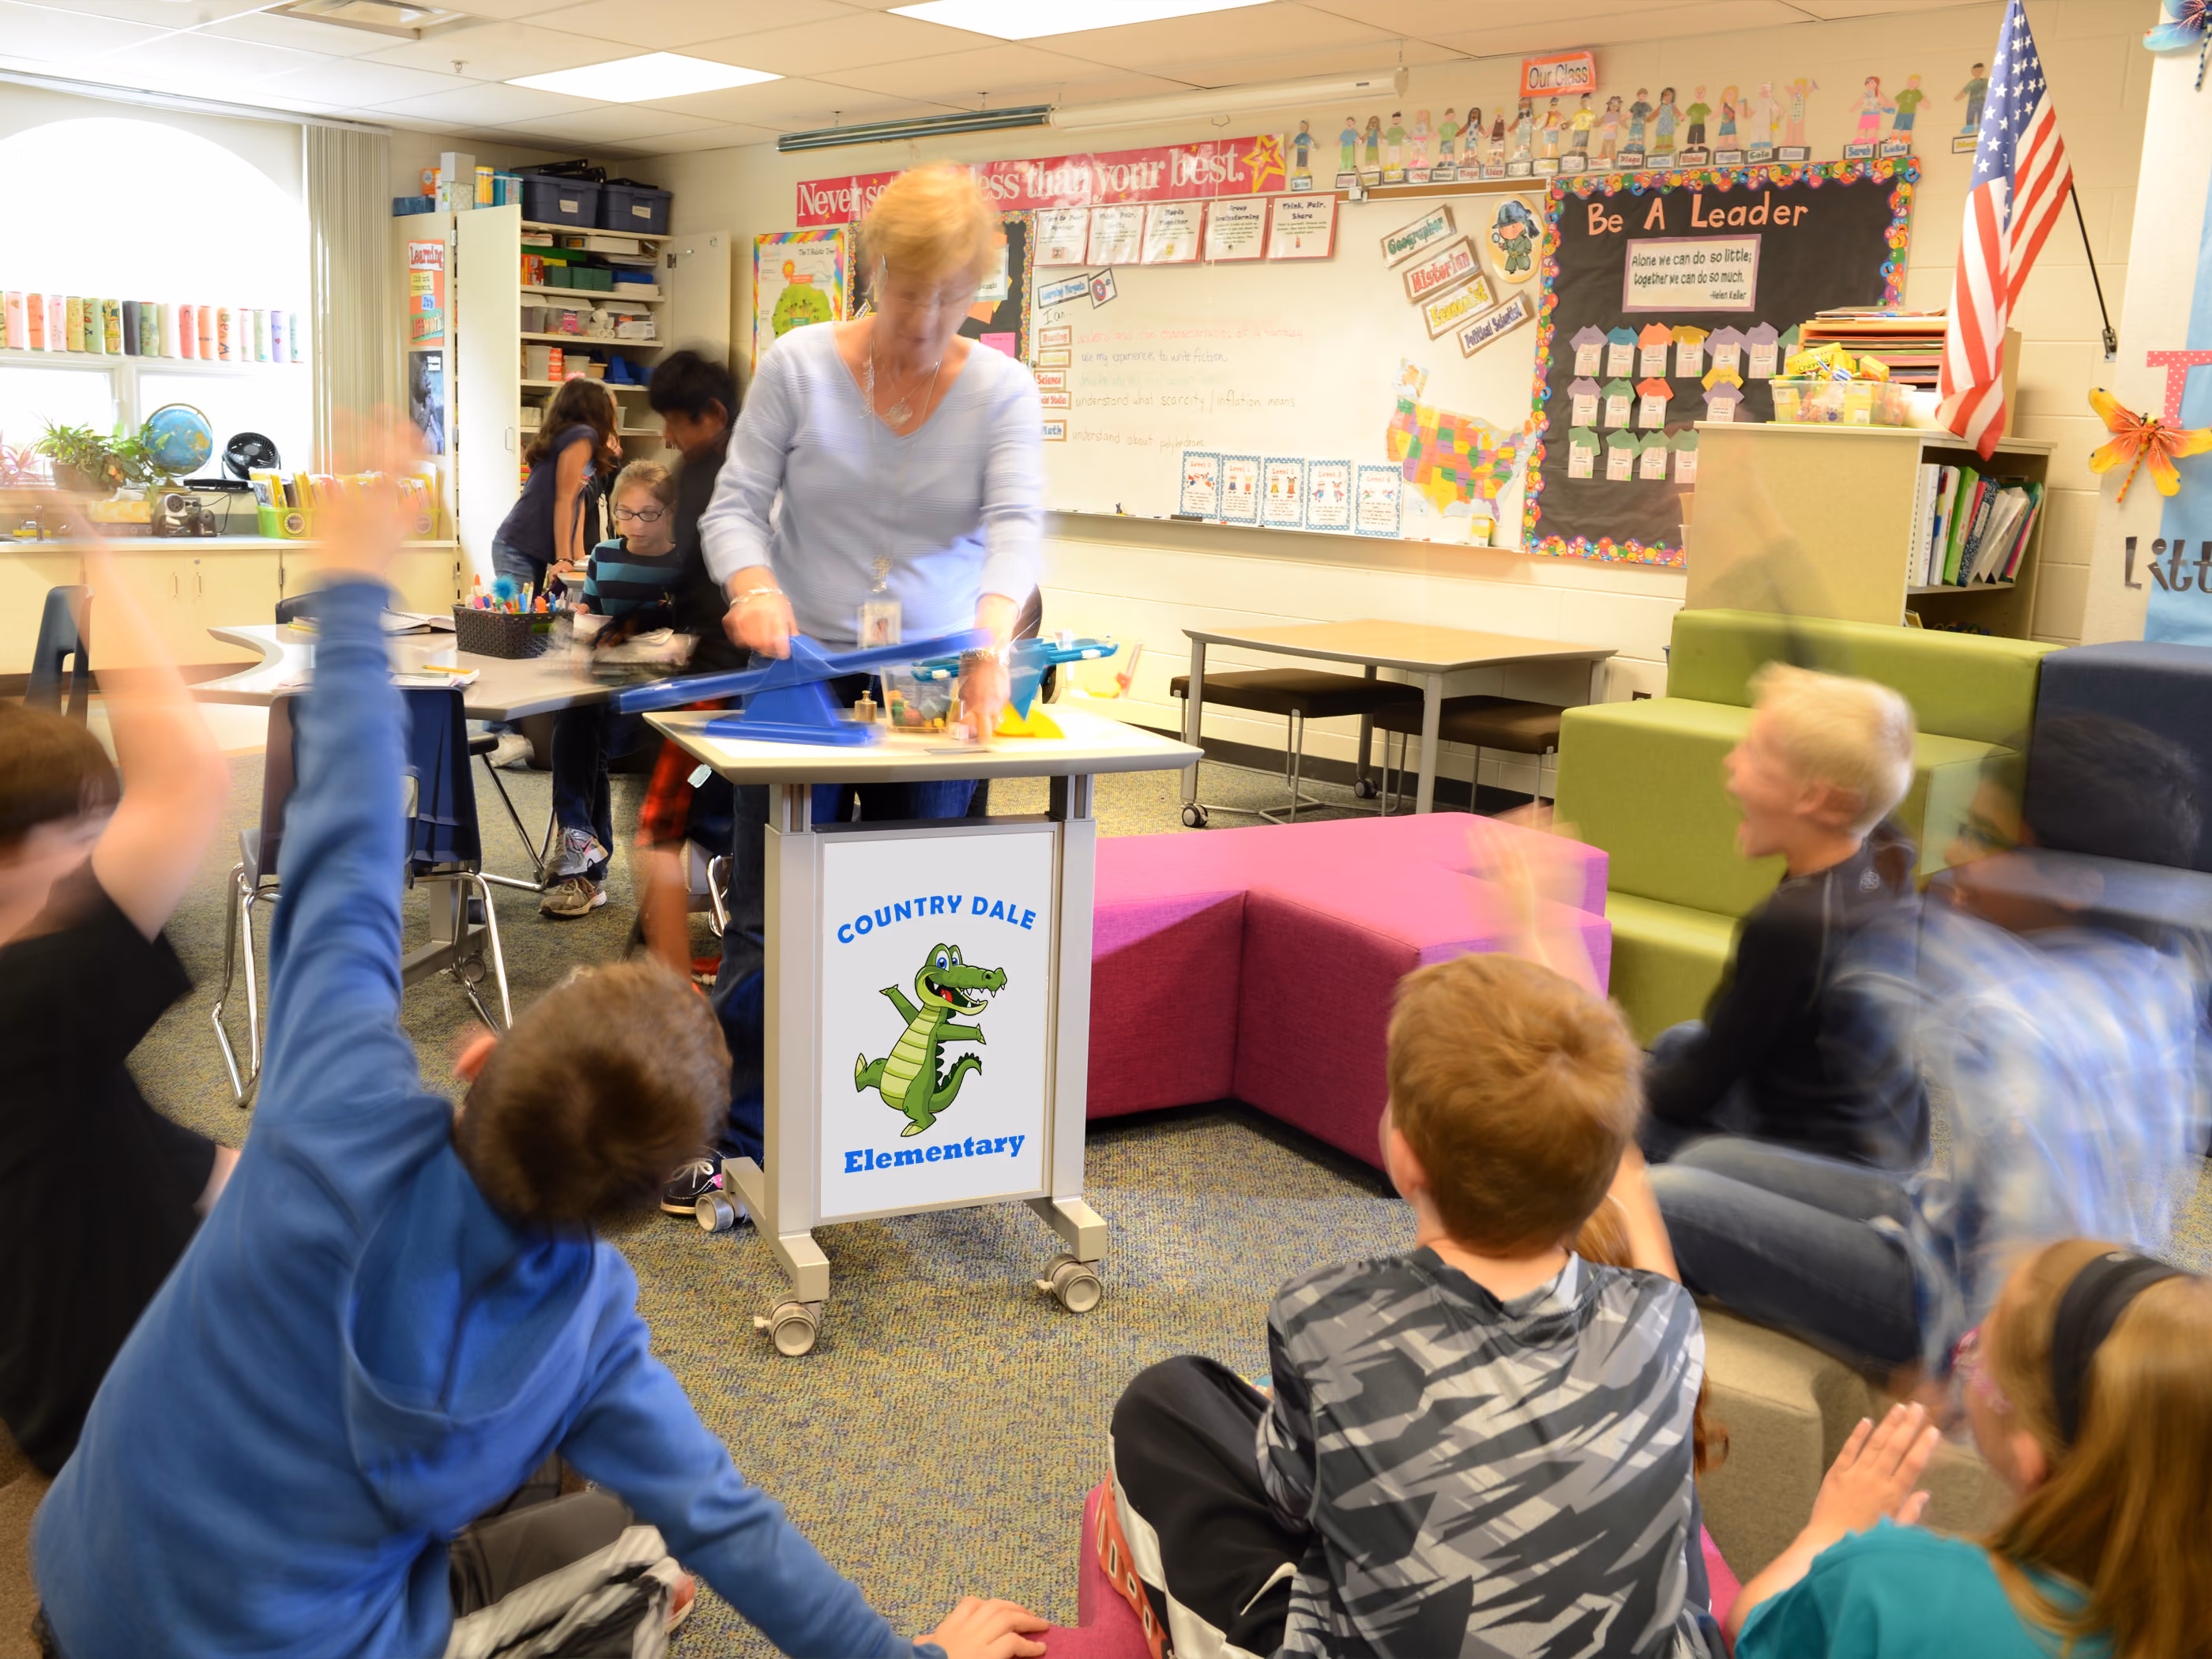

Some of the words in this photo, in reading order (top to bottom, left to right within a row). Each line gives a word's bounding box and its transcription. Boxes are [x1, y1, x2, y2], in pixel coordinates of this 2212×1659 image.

[1529, 67, 1552, 88] Our
[1556, 64, 1588, 86] Class
[798, 182, 863, 216] Never
[1027, 160, 1089, 198] than
[1093, 159, 1165, 203] your
[1169, 143, 1244, 187] best.
[1587, 202, 1623, 235] Be
[1643, 198, 1665, 231] A
[1691, 191, 1808, 228] Leader
[1388, 216, 1444, 254] Geographer
[409, 246, 443, 268] Learning
[1631, 254, 1657, 266] Alone
[1659, 254, 1670, 265] we
[1673, 254, 1691, 265] can
[1693, 250, 1706, 265] do
[1710, 253, 1722, 262] so
[1411, 250, 1470, 293] Historian
[1634, 273, 1668, 288] together
[1670, 274, 1679, 284] we
[1681, 274, 1695, 284] can
[1698, 270, 1707, 284] do
[1709, 273, 1719, 282] so
[1430, 280, 1488, 328] Economist
[1729, 290, 1747, 300] Keller
[1464, 322, 1493, 348] Political
[1082, 352, 1093, 362] use
[1097, 352, 1108, 367] my
[1036, 374, 1062, 386] Science
[1075, 392, 1128, 407] understand
[1133, 389, 1153, 405] what
[1161, 390, 1205, 414] scarcity
[1217, 389, 1261, 407] inflation
[1268, 397, 1296, 408] means
[837, 894, 962, 944] COUNTRY
[971, 896, 1036, 931] DALE
[844, 1134, 1025, 1174] Elementary
